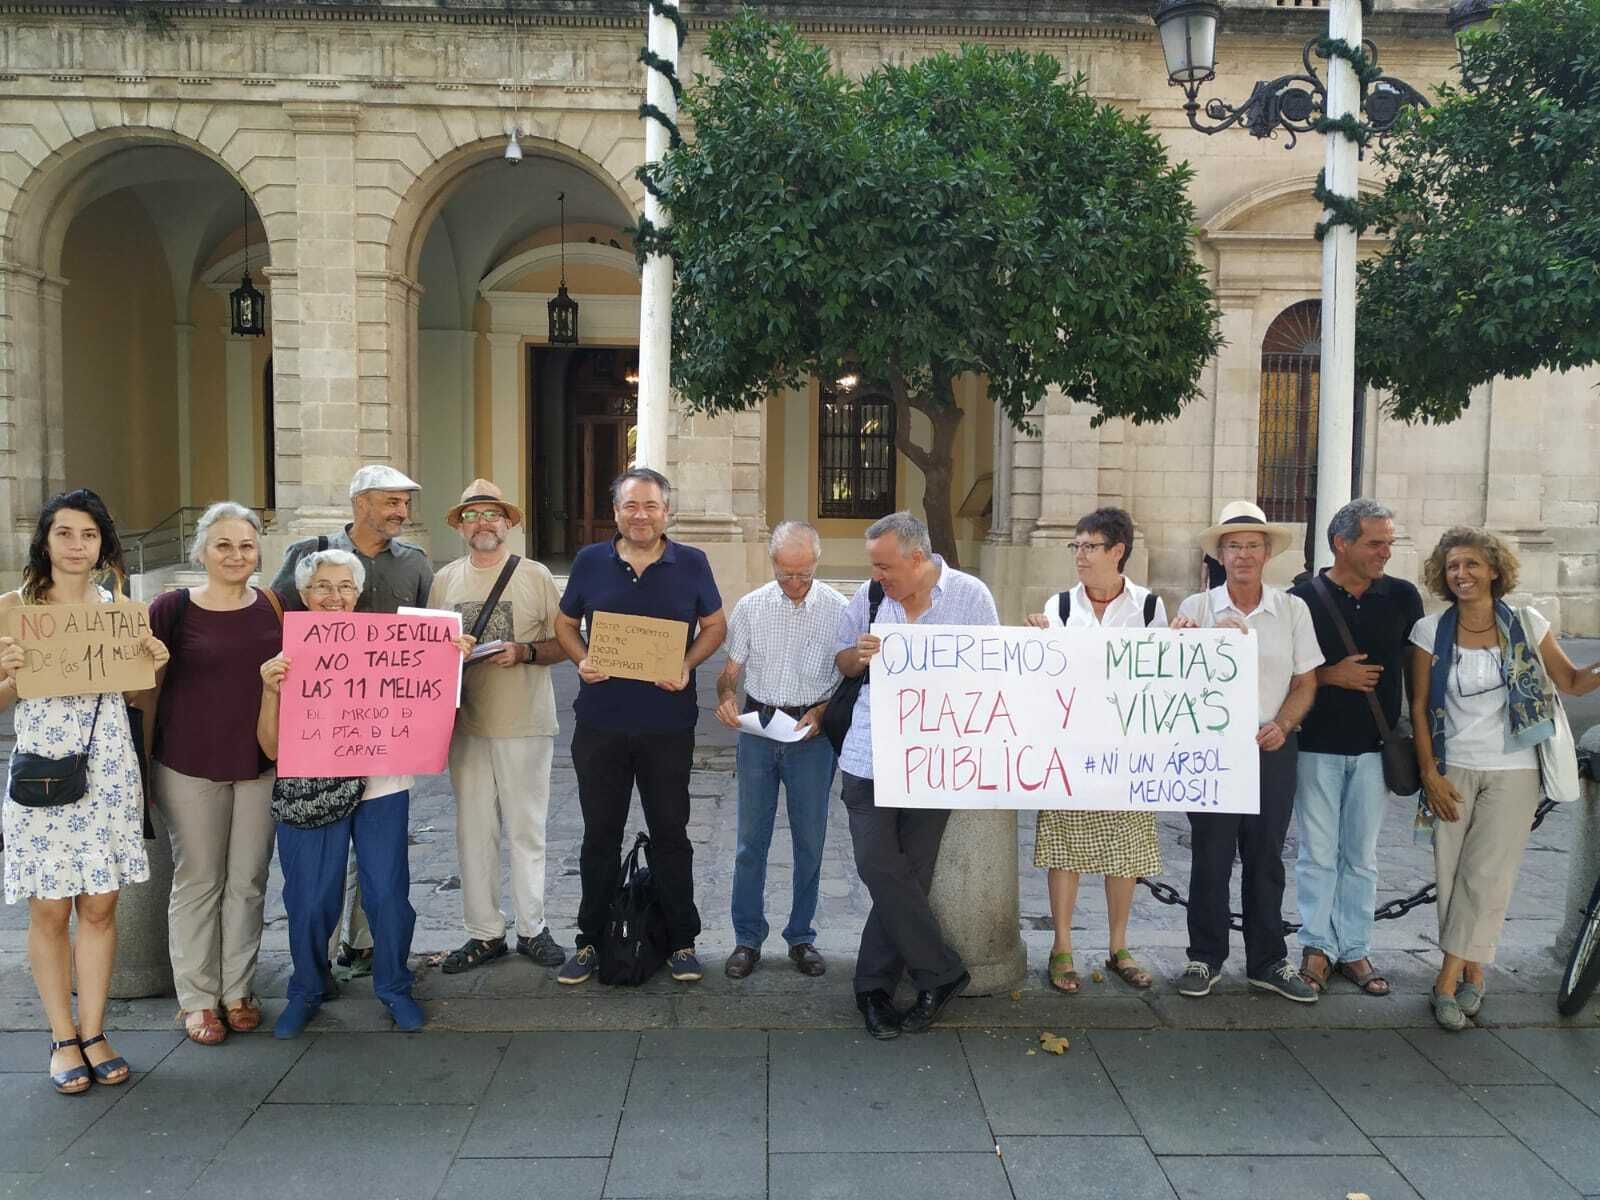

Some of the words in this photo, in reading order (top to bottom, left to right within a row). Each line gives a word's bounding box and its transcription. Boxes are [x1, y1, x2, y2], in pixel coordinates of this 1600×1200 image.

[21, 613, 57, 640] NO
[64, 613, 79, 633] A
[86, 611, 104, 631] LA
[105, 610, 149, 639] TALA
[384, 623, 452, 644] SEVILLA
[82, 644, 106, 680] 11
[315, 653, 349, 671] NO
[364, 650, 425, 668] TALES
[881, 632, 1067, 676] QUEREMOS
[302, 678, 335, 699] LAS
[343, 678, 366, 699] 11
[380, 677, 443, 701] MELIAS
[897, 688, 1018, 738] PLAZA
[1055, 687, 1076, 729] Y
[302, 728, 321, 740] LA
[391, 725, 409, 738] LA
[334, 745, 388, 757] CARNE
[1129, 751, 1155, 774] UN
[1164, 742, 1231, 775] ÁRBOL
[1129, 779, 1219, 807] MENOS!!
